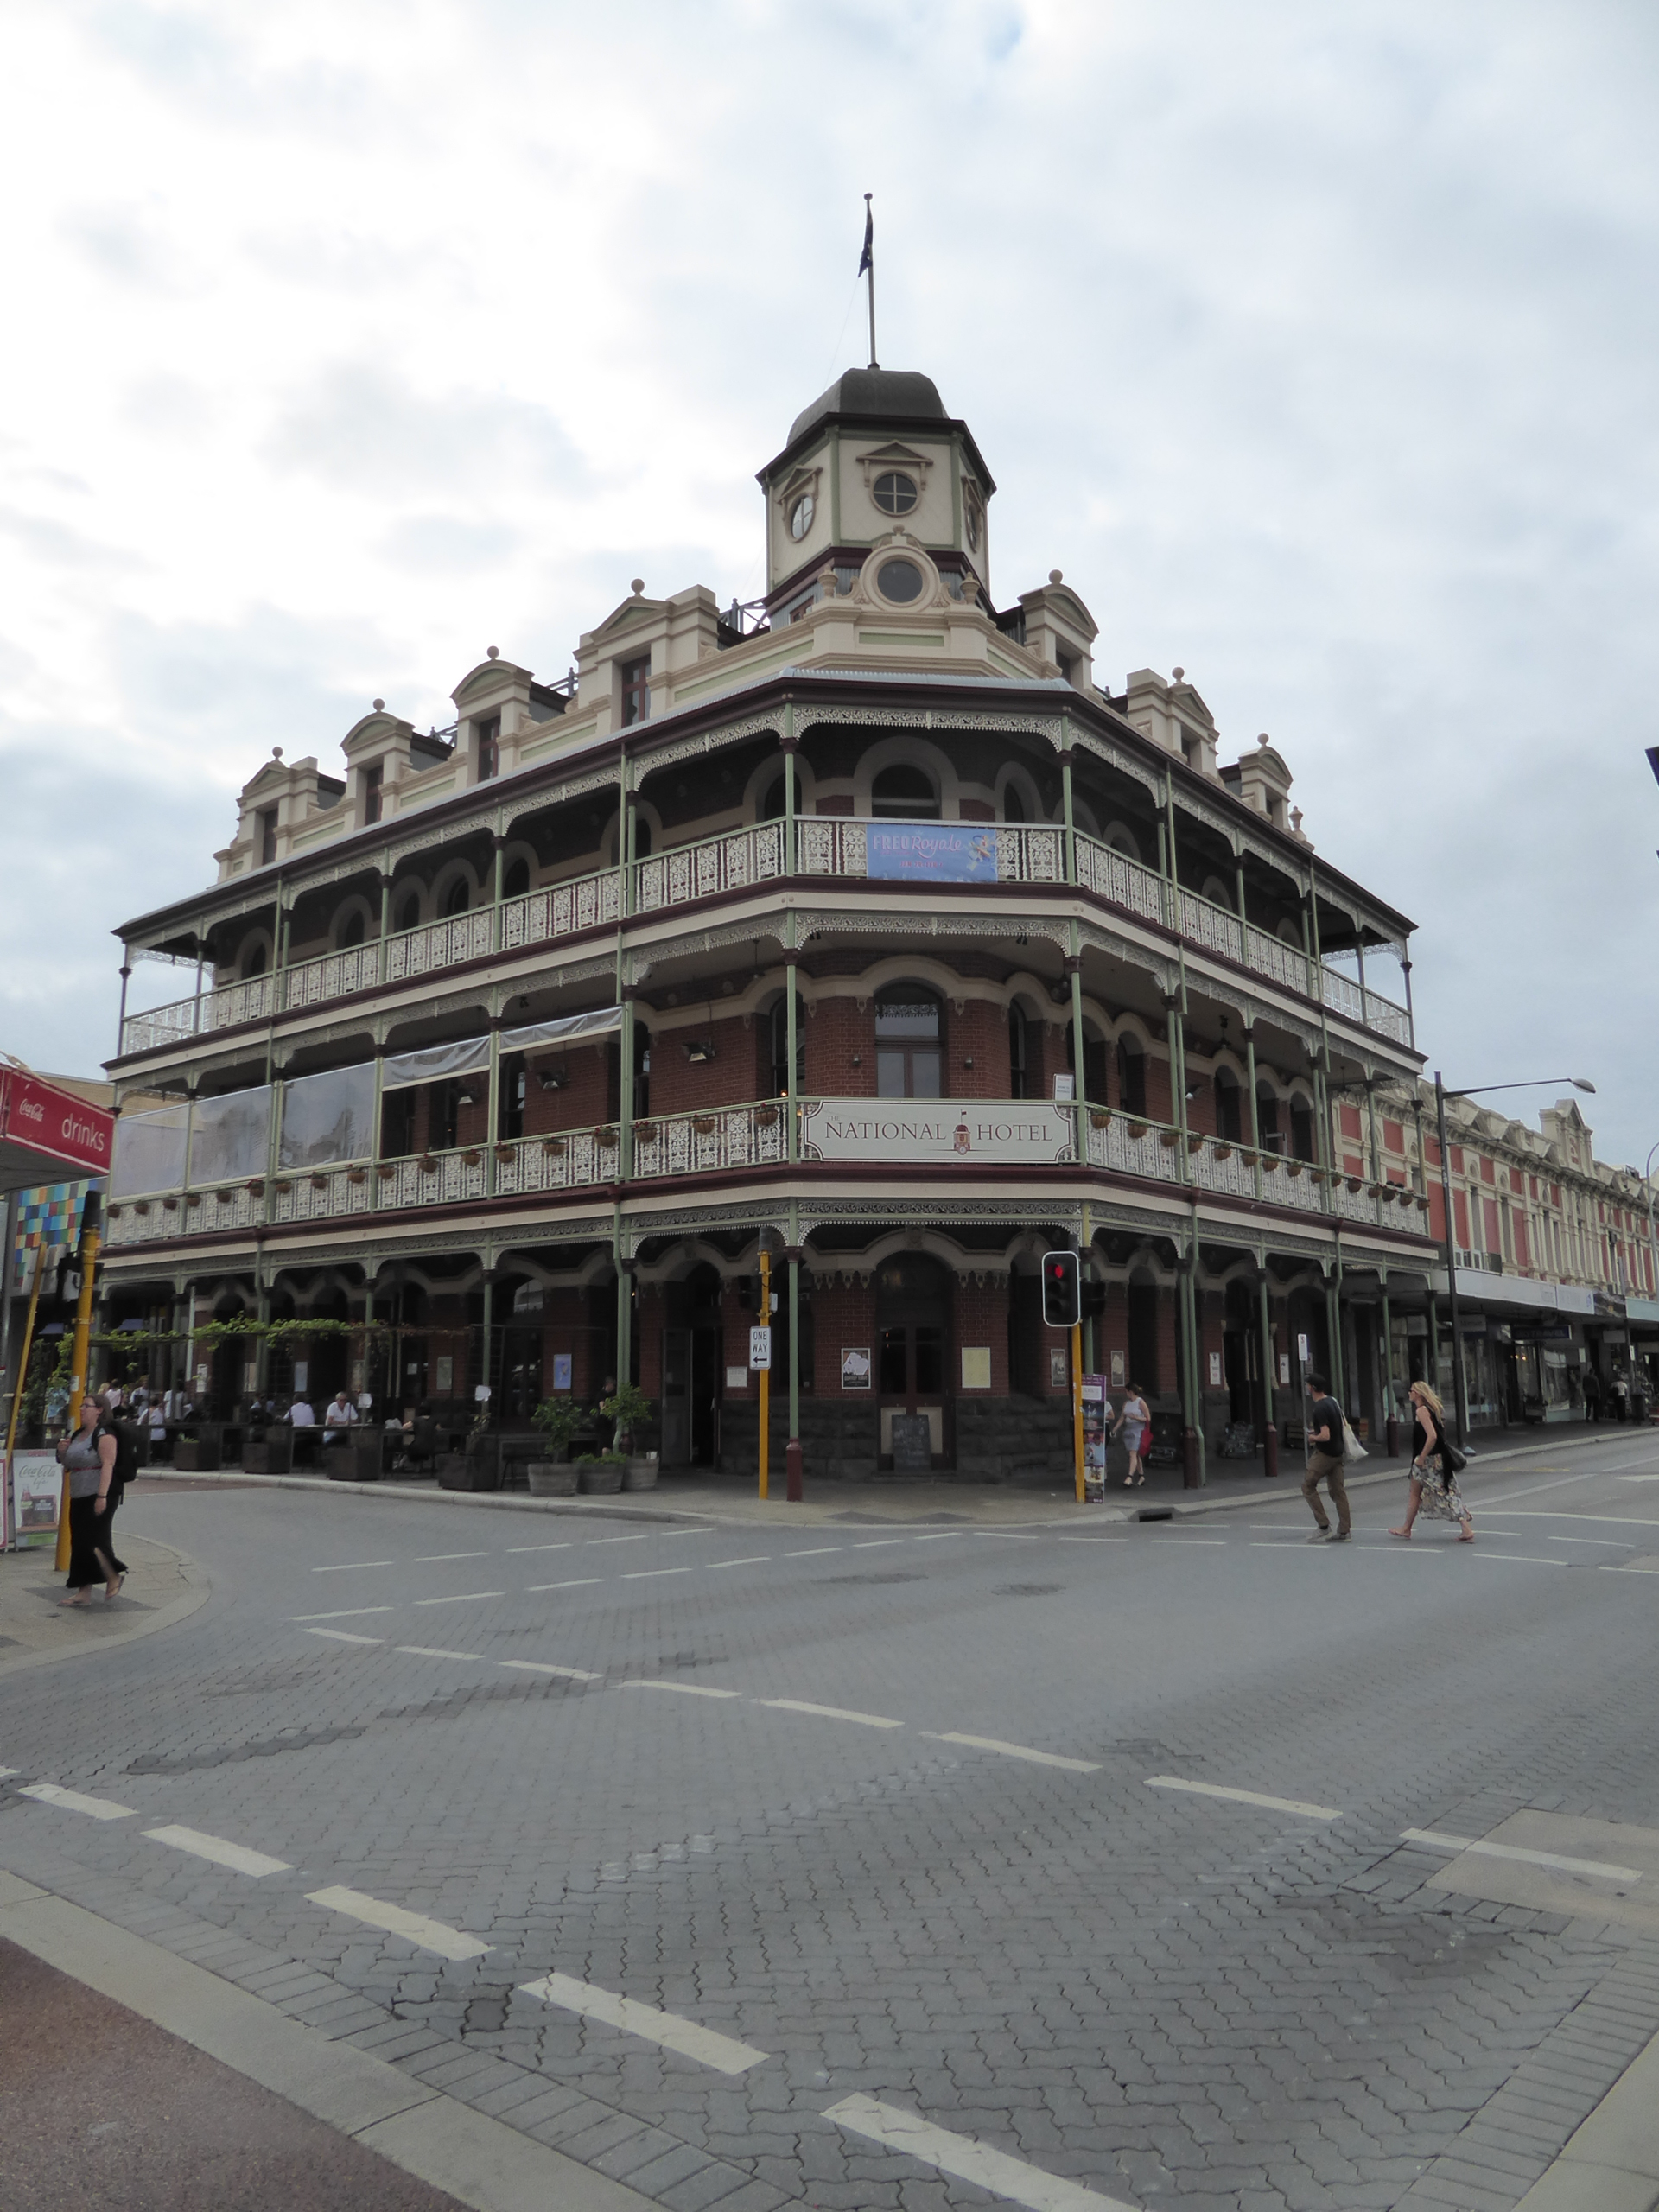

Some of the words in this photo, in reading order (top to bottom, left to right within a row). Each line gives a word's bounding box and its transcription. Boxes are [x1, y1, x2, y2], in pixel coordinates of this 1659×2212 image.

[873, 835, 909, 849] FREO
[912, 834, 963, 859] Royale
[19, 1098, 46, 1122] Coca-Cola
[61, 1113, 105, 1152] drinks
[825, 1122, 947, 1141] NATIONAL
[976, 1124, 1053, 1141] HOTEL
[753, 1331, 766, 1340] ONE
[752, 1344, 767, 1353] WAY
